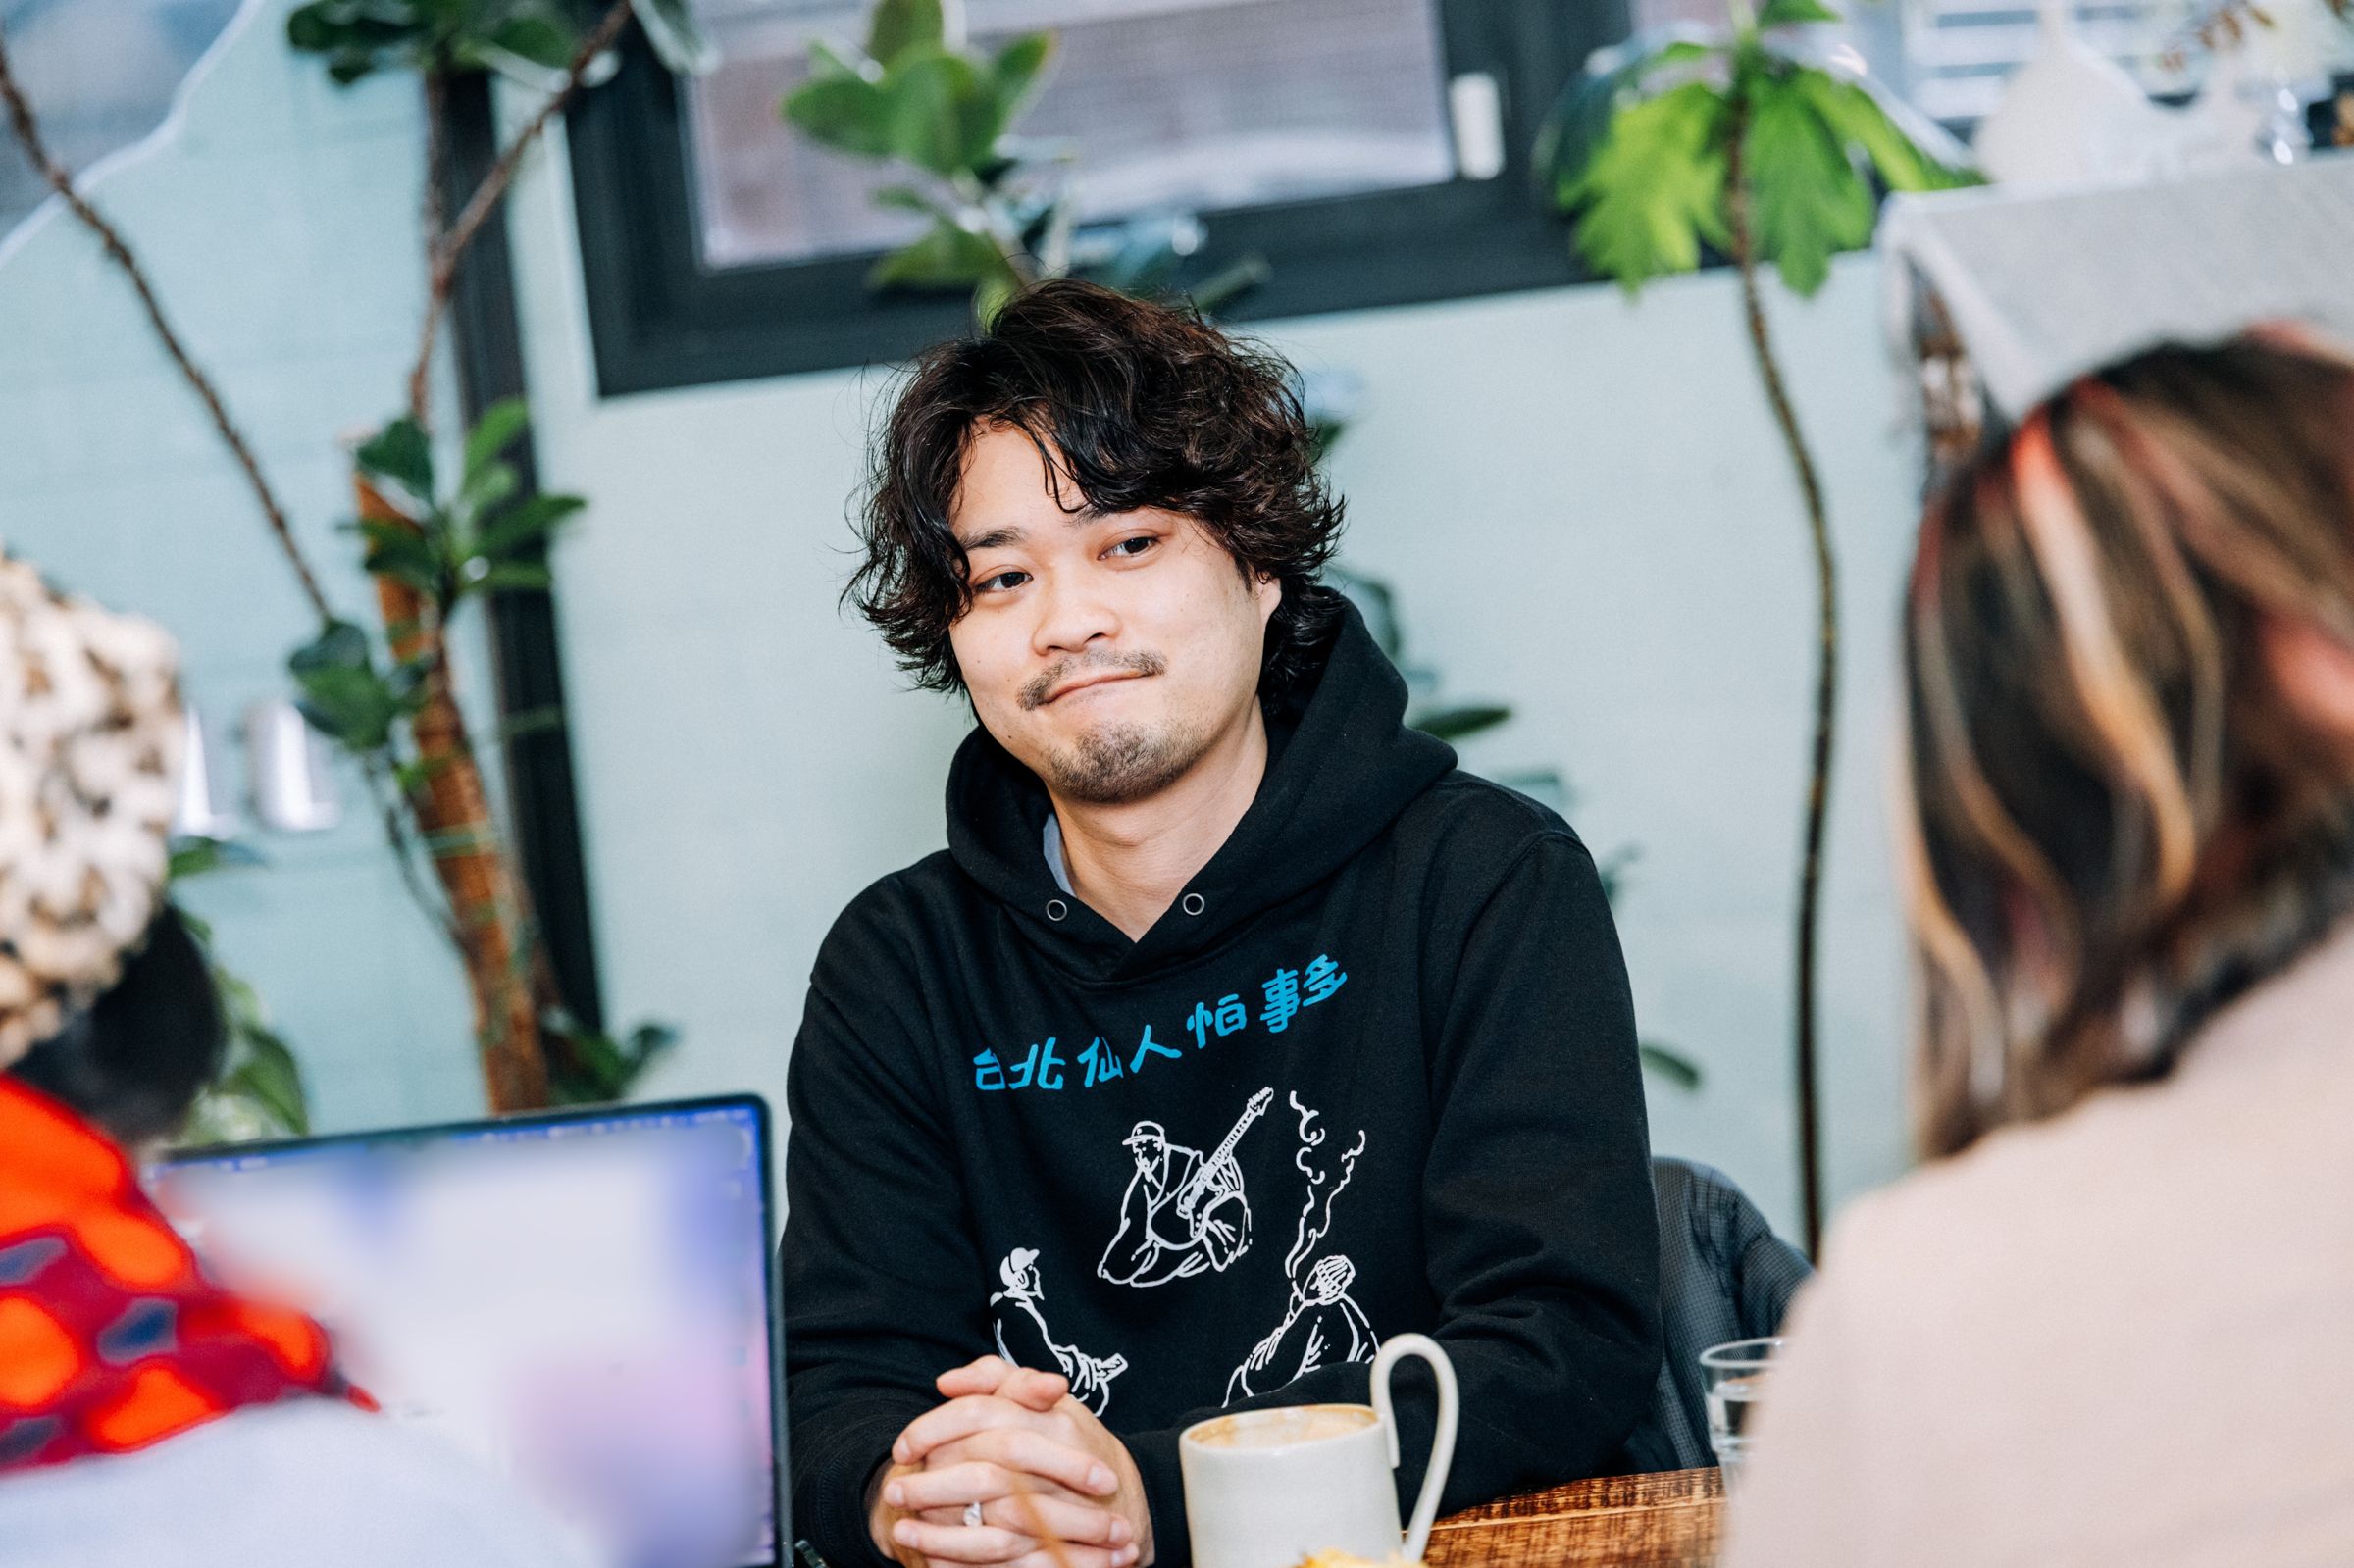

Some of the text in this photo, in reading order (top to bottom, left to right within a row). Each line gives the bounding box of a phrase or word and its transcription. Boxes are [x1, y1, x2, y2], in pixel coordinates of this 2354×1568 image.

[973, 953, 1348, 1090] 台北仙人怕事多
